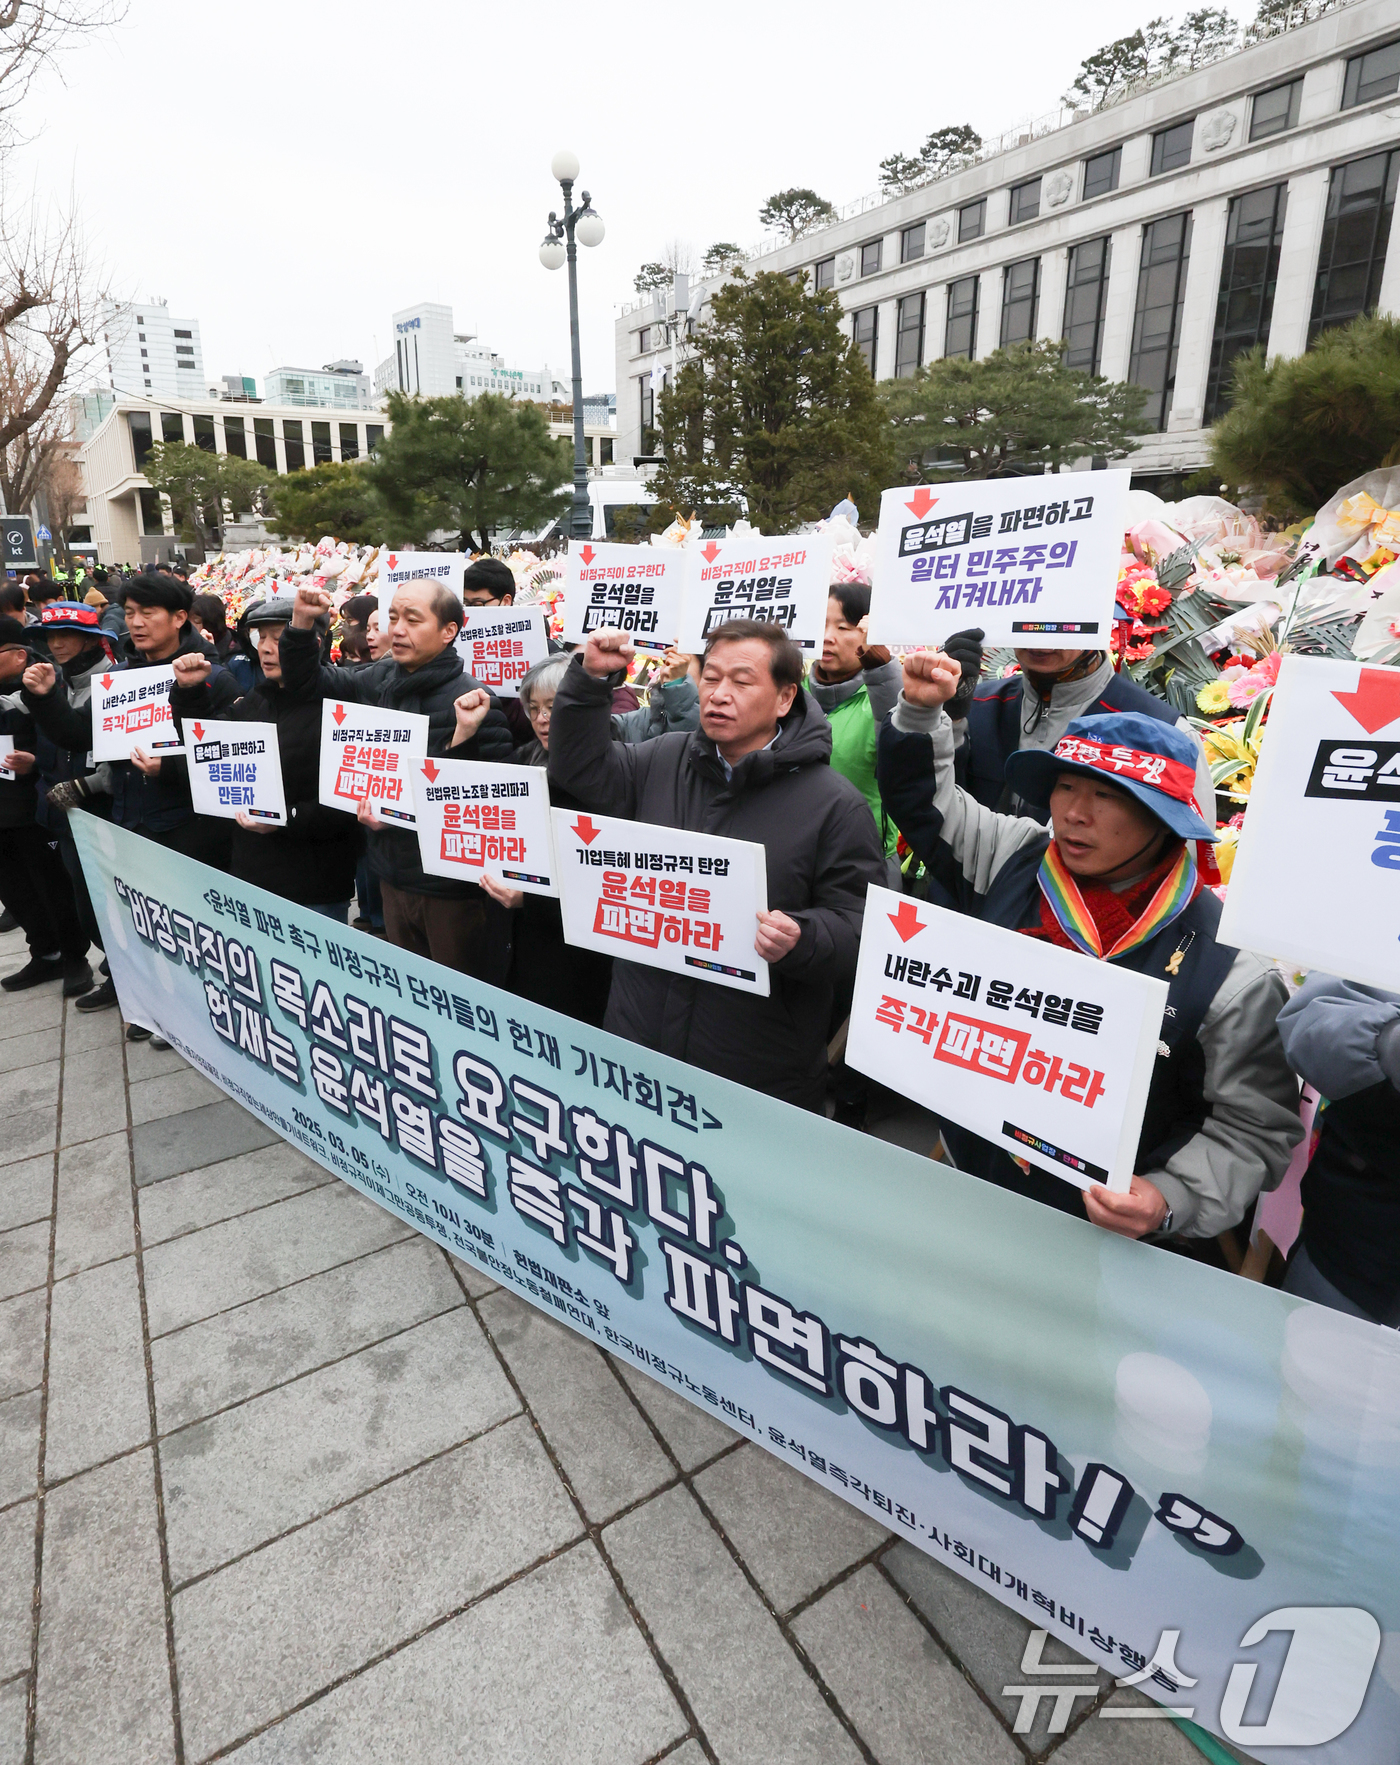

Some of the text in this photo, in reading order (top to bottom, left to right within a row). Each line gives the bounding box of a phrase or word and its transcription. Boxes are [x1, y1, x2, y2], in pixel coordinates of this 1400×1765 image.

[500, 369, 523, 380] 하나은행
[903, 496, 1094, 551] 윤석열을 파면하고
[12, 547, 23, 555] kt
[911, 540, 1078, 583] 일터 민주주의
[411, 567, 436, 580] 비정규직
[437, 565, 451, 577] 탄압
[580, 563, 665, 581] 비정규직이 요구한다
[700, 550, 807, 581] 비정규직이 요구한다
[591, 582, 655, 605] 윤석열을
[713, 576, 793, 605] 윤석열을
[934, 577, 1043, 610] 지켜내자
[460, 619, 532, 642] 헌법유린 노조할 권리파괴
[472, 639, 523, 660] 윤석열을
[102, 690, 136, 710] 내란수괴
[102, 716, 126, 732] 즉각
[332, 729, 411, 743] 비정규직 노동권 파괴
[195, 743, 229, 761] 윤석열을
[231, 740, 266, 757] 파면하고
[342, 745, 399, 772] 윤석열을
[208, 763, 257, 783] 평등세상
[1104, 747, 1166, 784] 투쟁
[218, 786, 255, 806] 만들자
[338, 770, 403, 801] 파면하라
[426, 782, 529, 801] 헌법유린 노조할 권리파괴
[444, 803, 516, 830] 윤석열을
[443, 833, 527, 863] 파면하라
[576, 849, 730, 876] 기업특혜 비정규직 탄압
[602, 871, 711, 914] 윤석열을
[601, 903, 724, 952] 파면하라
[884, 953, 1104, 1035] 내란수괴 윤석열을
[253, 907, 285, 944] 파면
[288, 923, 322, 959] 촉구
[325, 939, 402, 998] 비정규직
[406, 974, 500, 1042] 단위들의
[507, 1018, 561, 1070] 헌재
[571, 1044, 723, 1134] 기자회견>
[875, 995, 1106, 1109] 즉각 파면하라
[271, 957, 440, 1102] 목소리로
[453, 1049, 747, 1269] 요구한다.
[204, 979, 301, 1087] 헌재는
[311, 1041, 489, 1201] 윤석열을
[507, 1151, 636, 1285] 즉각
[405, 1182, 429, 1208] 오전
[432, 1199, 461, 1228] 10시
[463, 1218, 495, 1250] 30분
[512, 1249, 591, 1309] 헌법재판소
[593, 1298, 611, 1322] 앞
[604, 1325, 762, 1435] 한국비정규노동센터,
